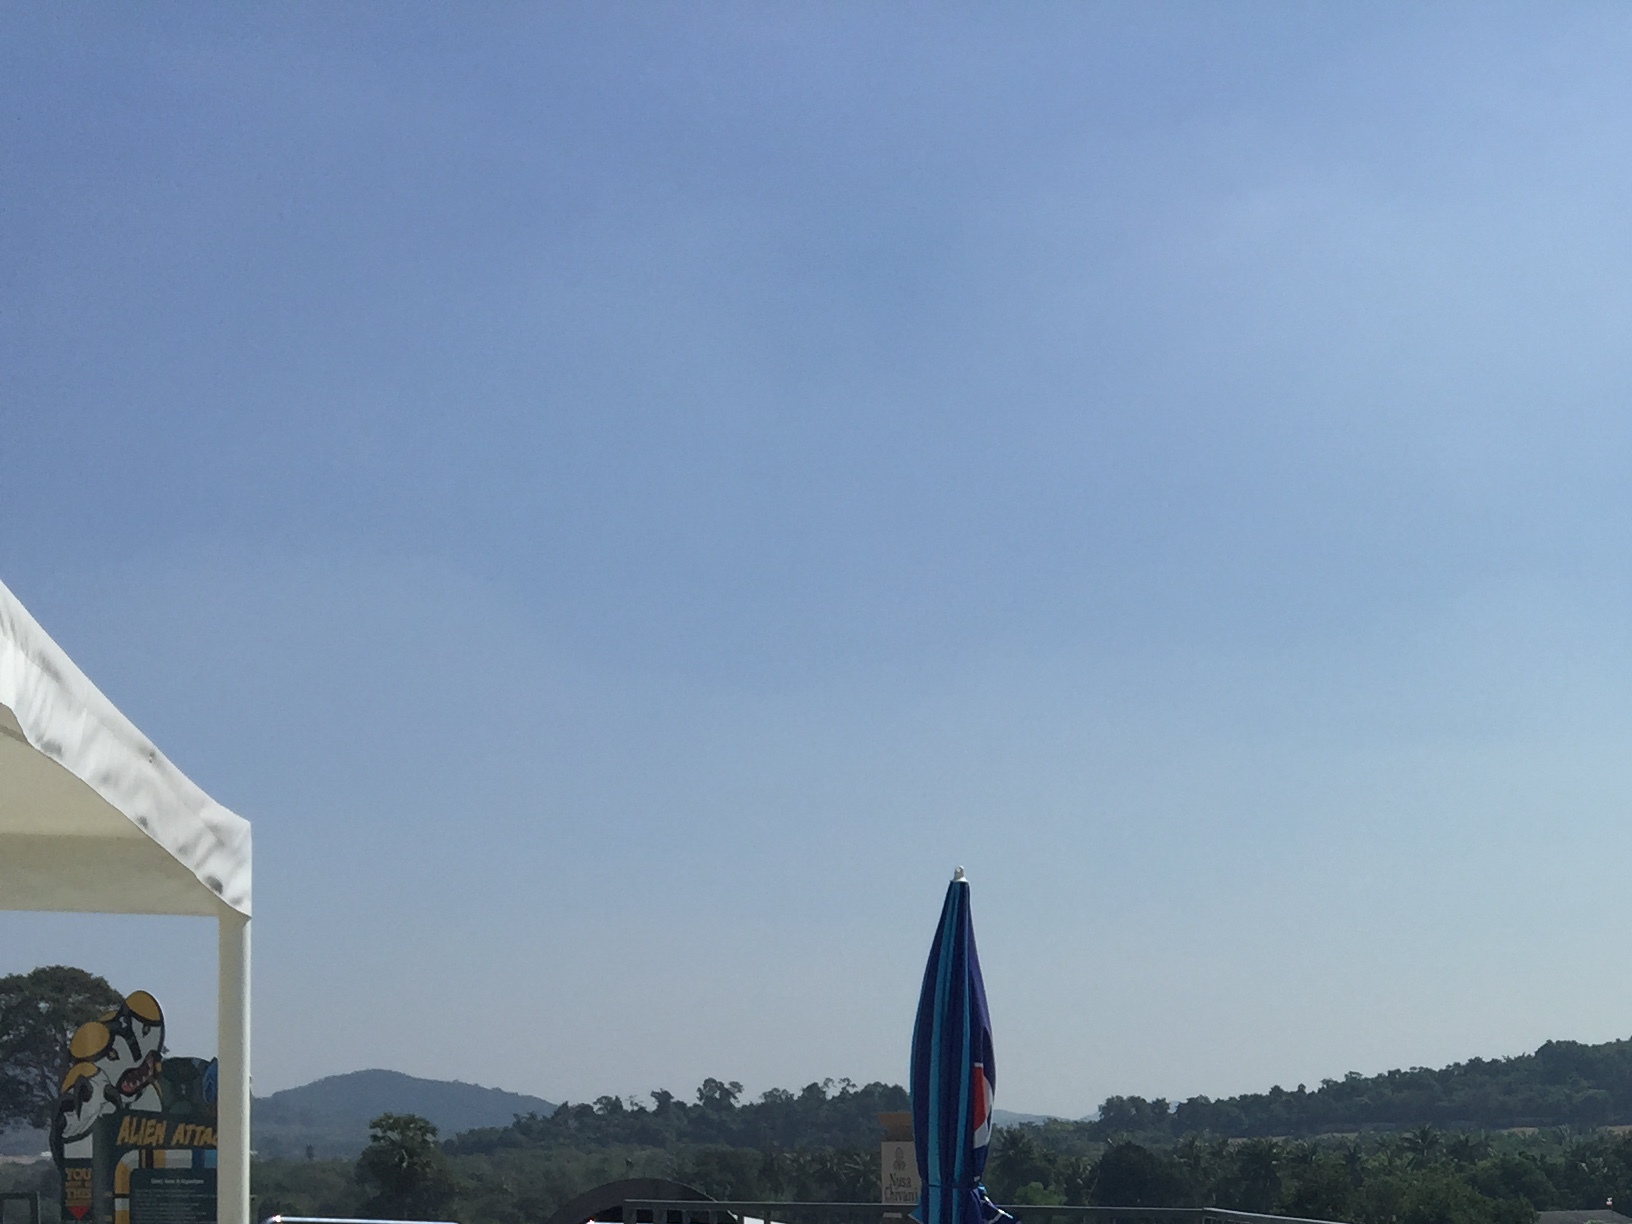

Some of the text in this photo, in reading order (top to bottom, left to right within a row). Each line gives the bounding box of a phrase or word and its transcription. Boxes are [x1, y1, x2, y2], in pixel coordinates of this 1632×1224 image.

[115, 1114, 218, 1146] ALIEN ATTA
[64, 1167, 92, 1180] YOU
[889, 1172, 912, 1188] Nusa
